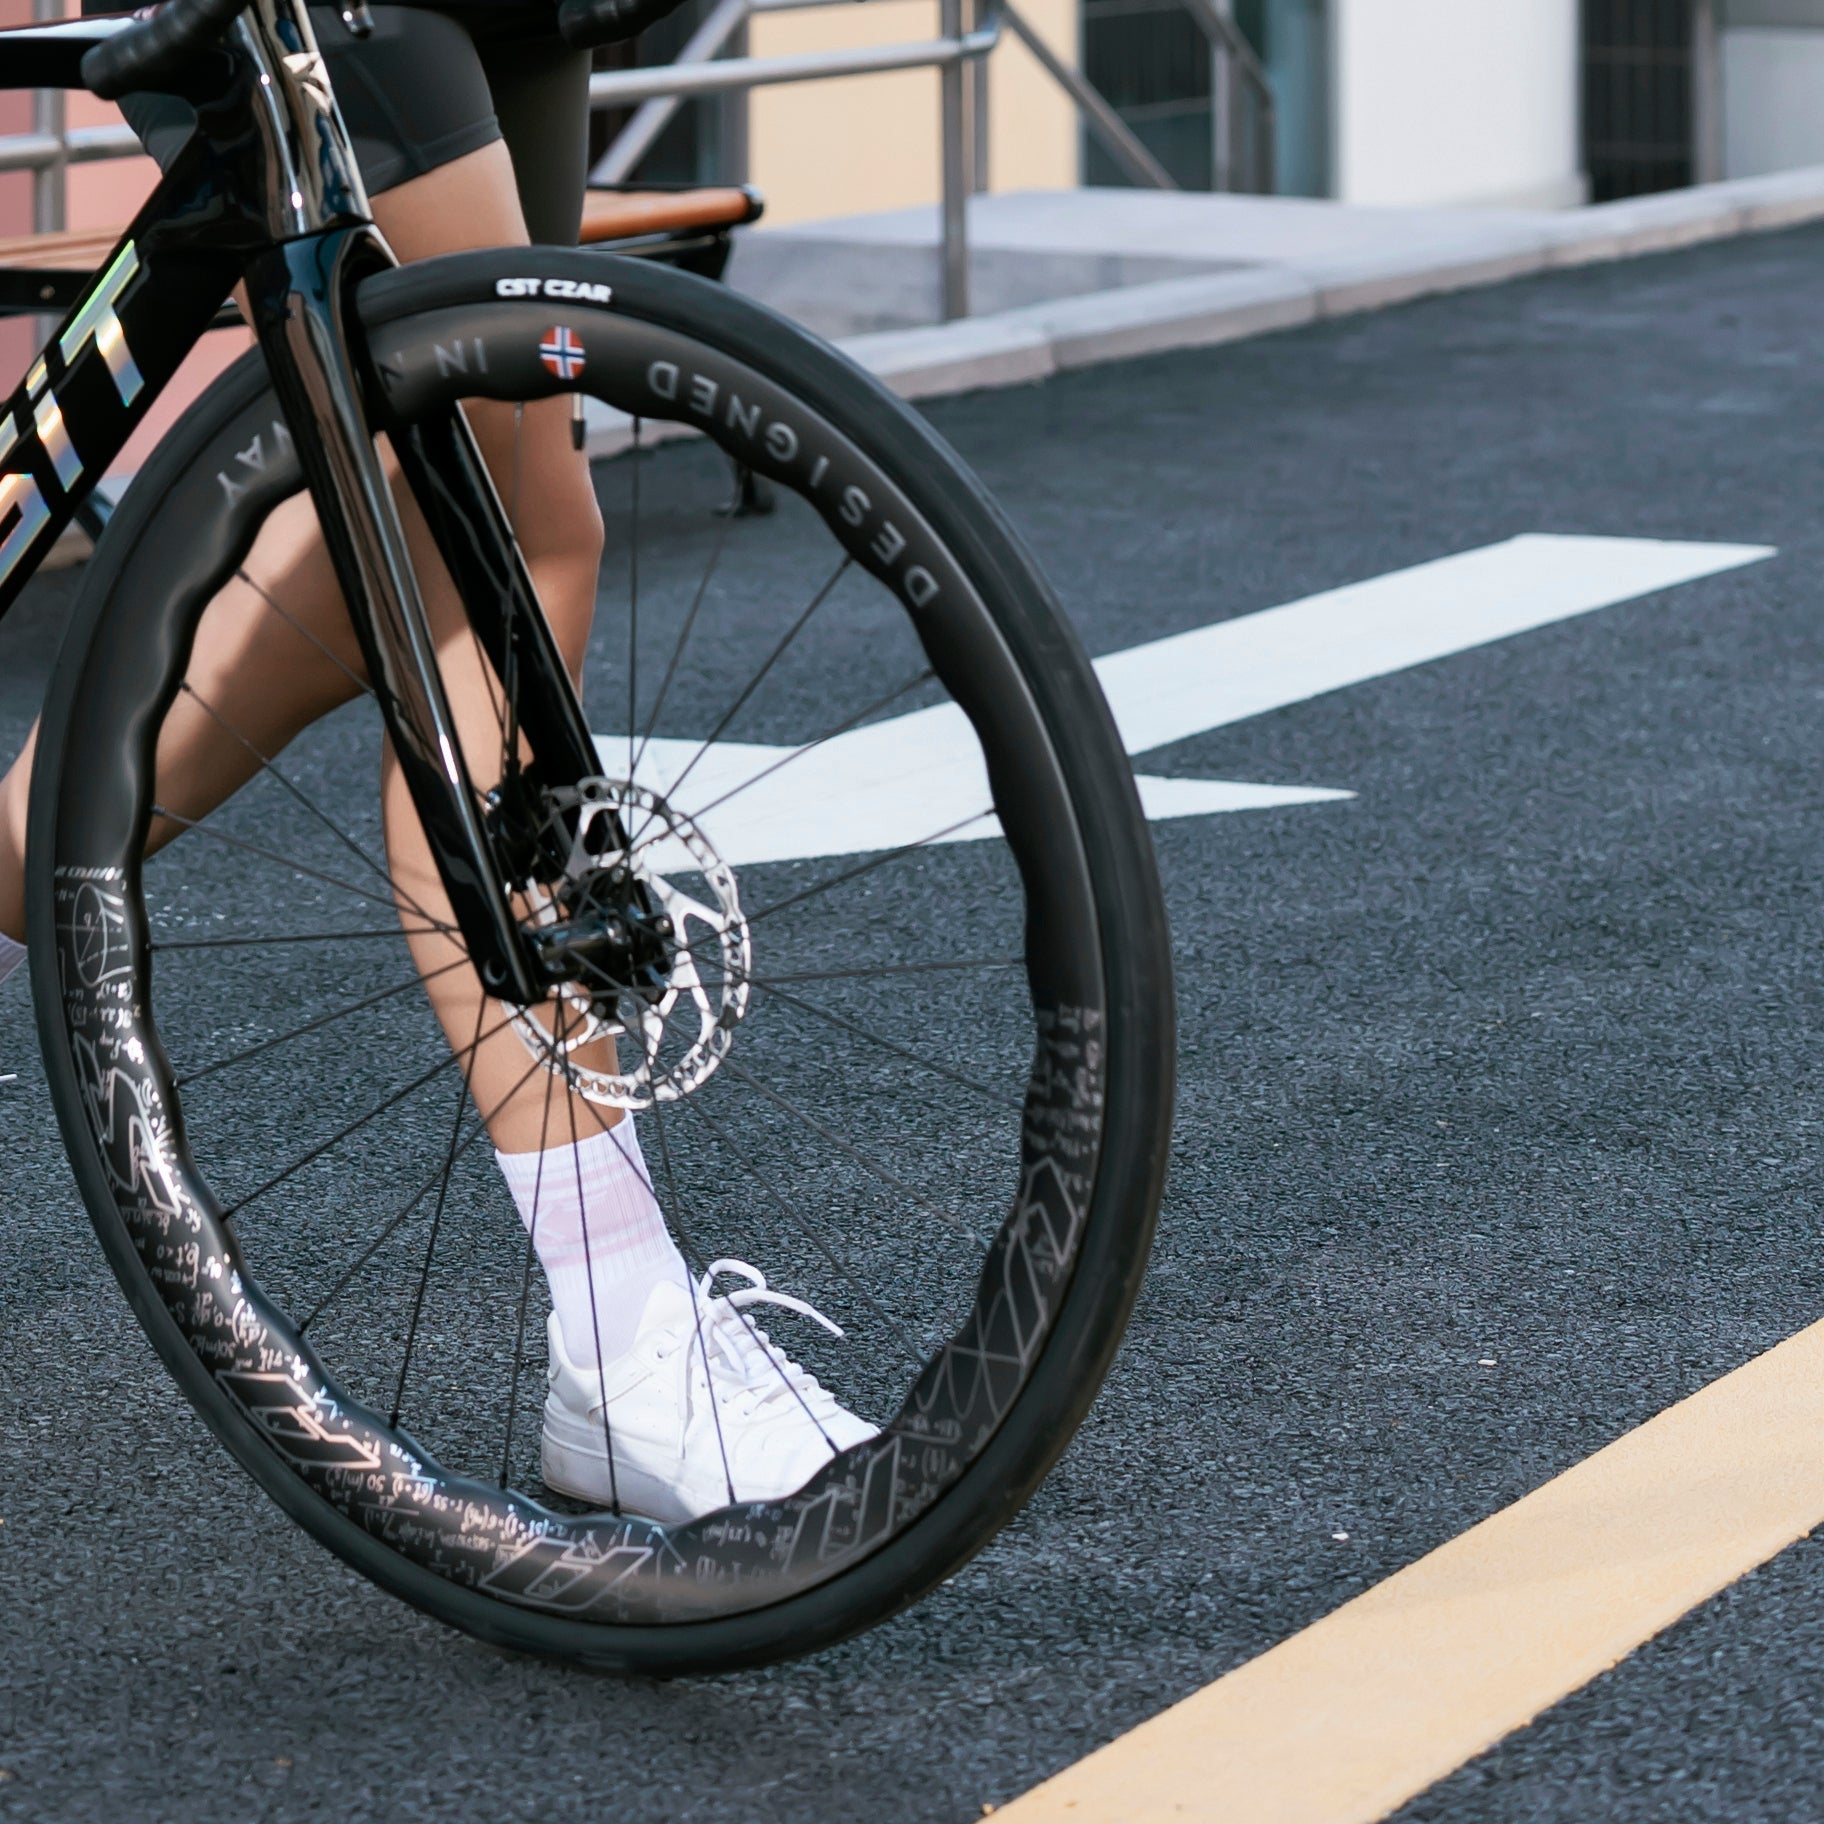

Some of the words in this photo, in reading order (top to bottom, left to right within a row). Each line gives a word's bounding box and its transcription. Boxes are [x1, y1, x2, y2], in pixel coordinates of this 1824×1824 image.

[496, 277, 542, 297] CST
[543, 278, 613, 304] CZAR
[646, 360, 941, 609] DESIGNED
